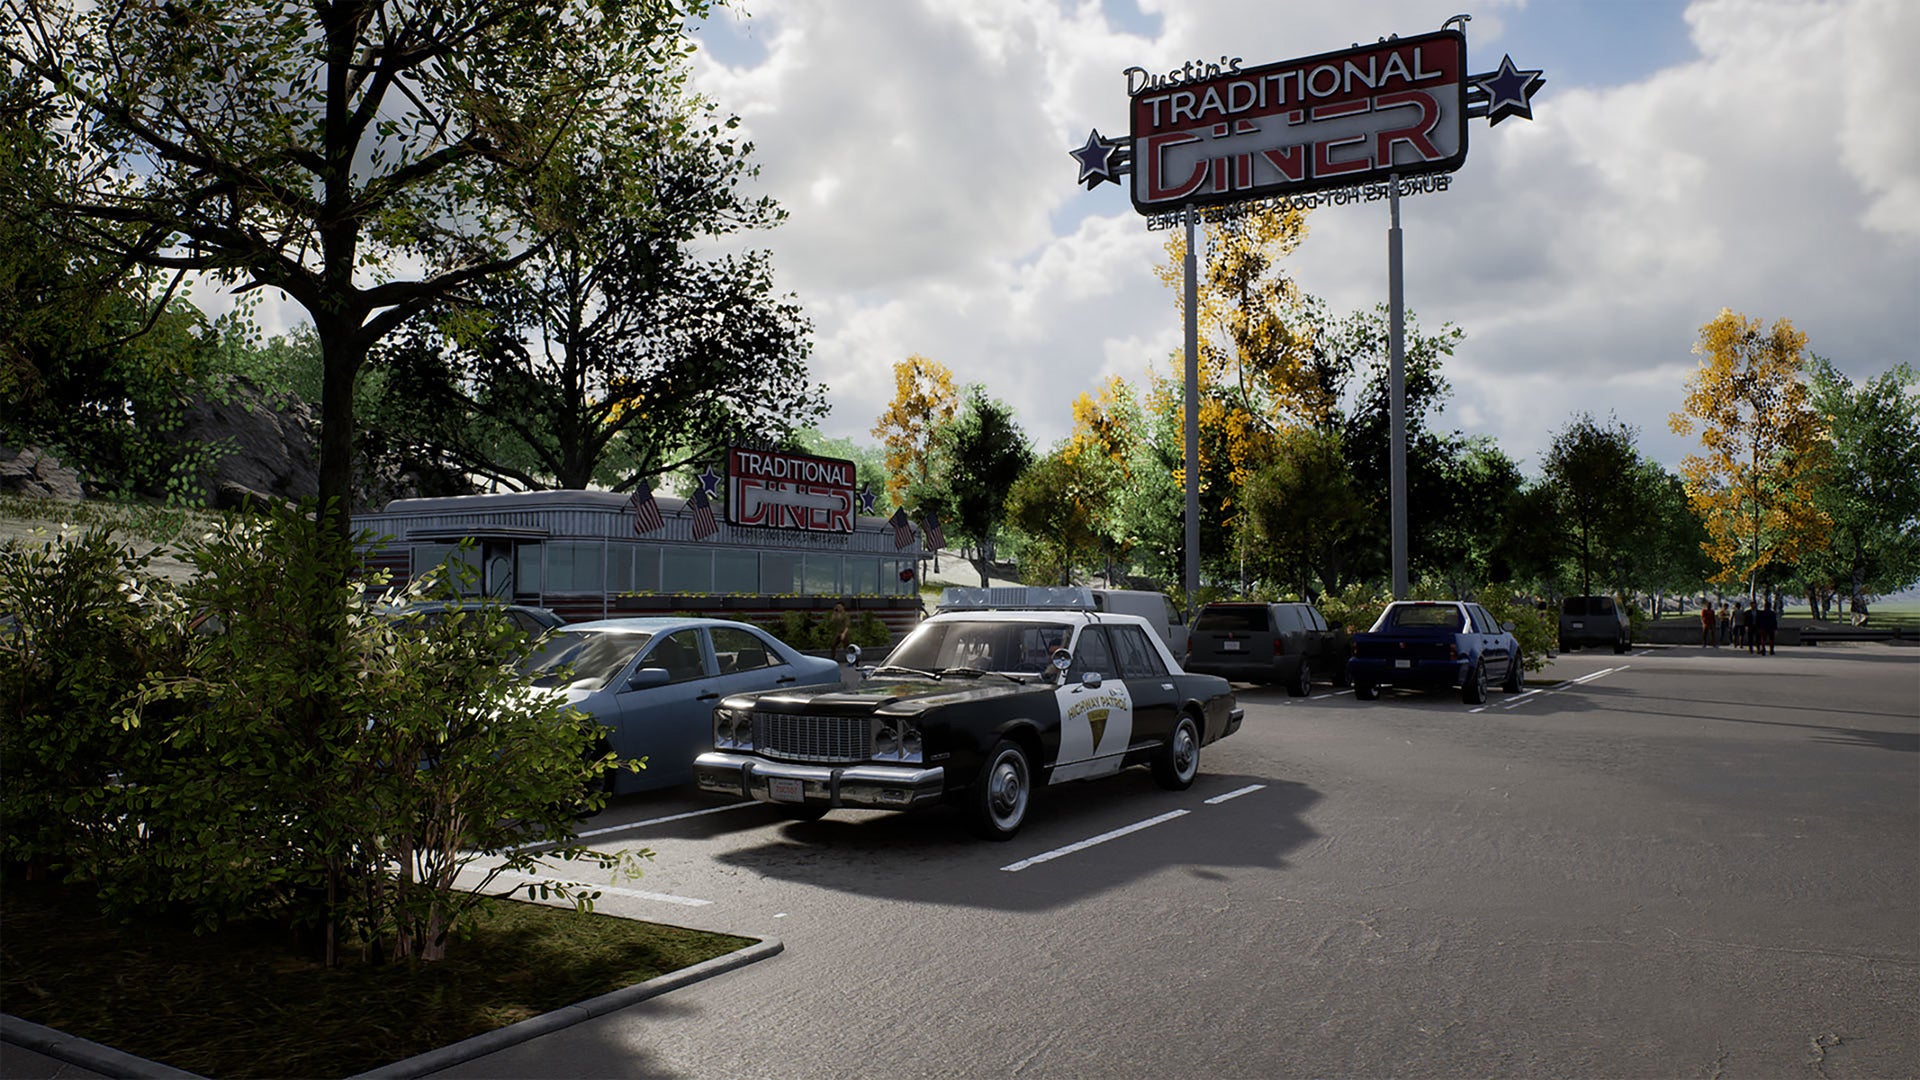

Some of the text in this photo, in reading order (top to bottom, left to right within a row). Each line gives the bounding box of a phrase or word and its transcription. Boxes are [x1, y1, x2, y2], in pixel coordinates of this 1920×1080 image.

[1123, 55, 1243, 97] Dustin's
[1143, 47, 1442, 127] TRADITIONAL
[1147, 89, 1445, 201] DINER
[737, 452, 852, 487] TRADITIONAL
[739, 479, 853, 533] DINER
[1067, 695, 1128, 720] HIGHWAY PATROL
